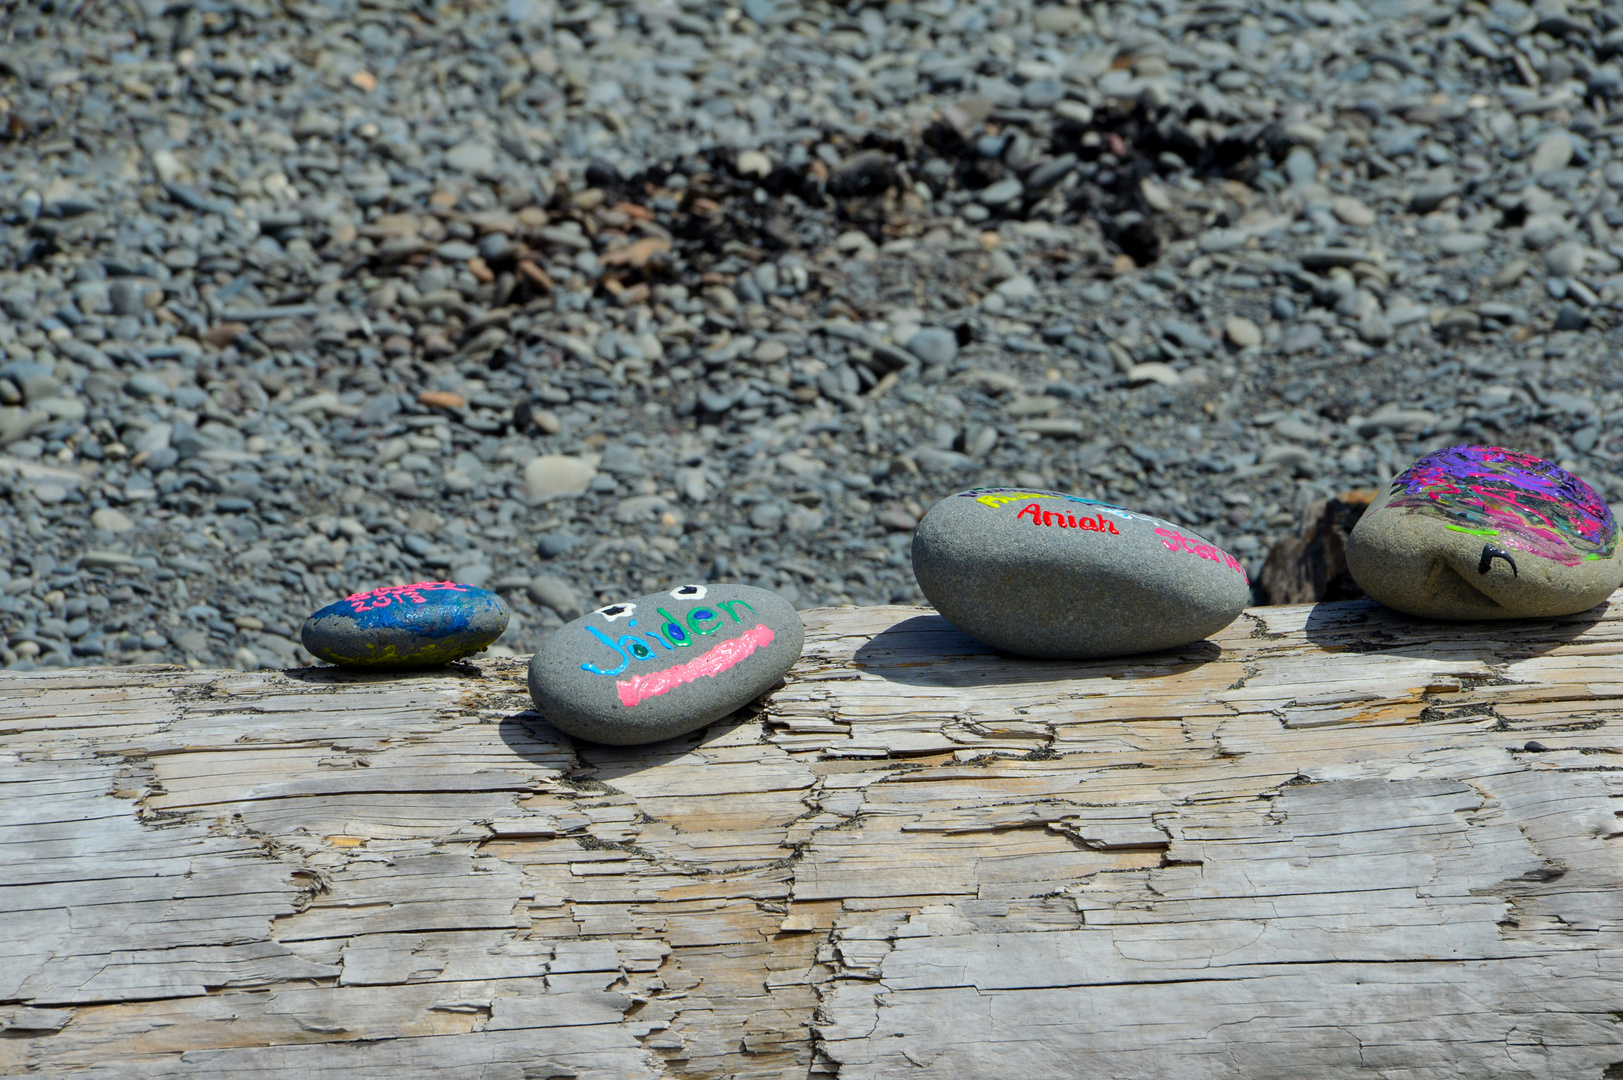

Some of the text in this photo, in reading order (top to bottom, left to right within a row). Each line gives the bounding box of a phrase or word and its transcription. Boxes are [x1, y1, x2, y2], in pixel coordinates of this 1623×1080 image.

[1017, 503, 1120, 535] Aniah
[351, 591, 427, 613] 2013
[580, 600, 760, 676] Jaiden
